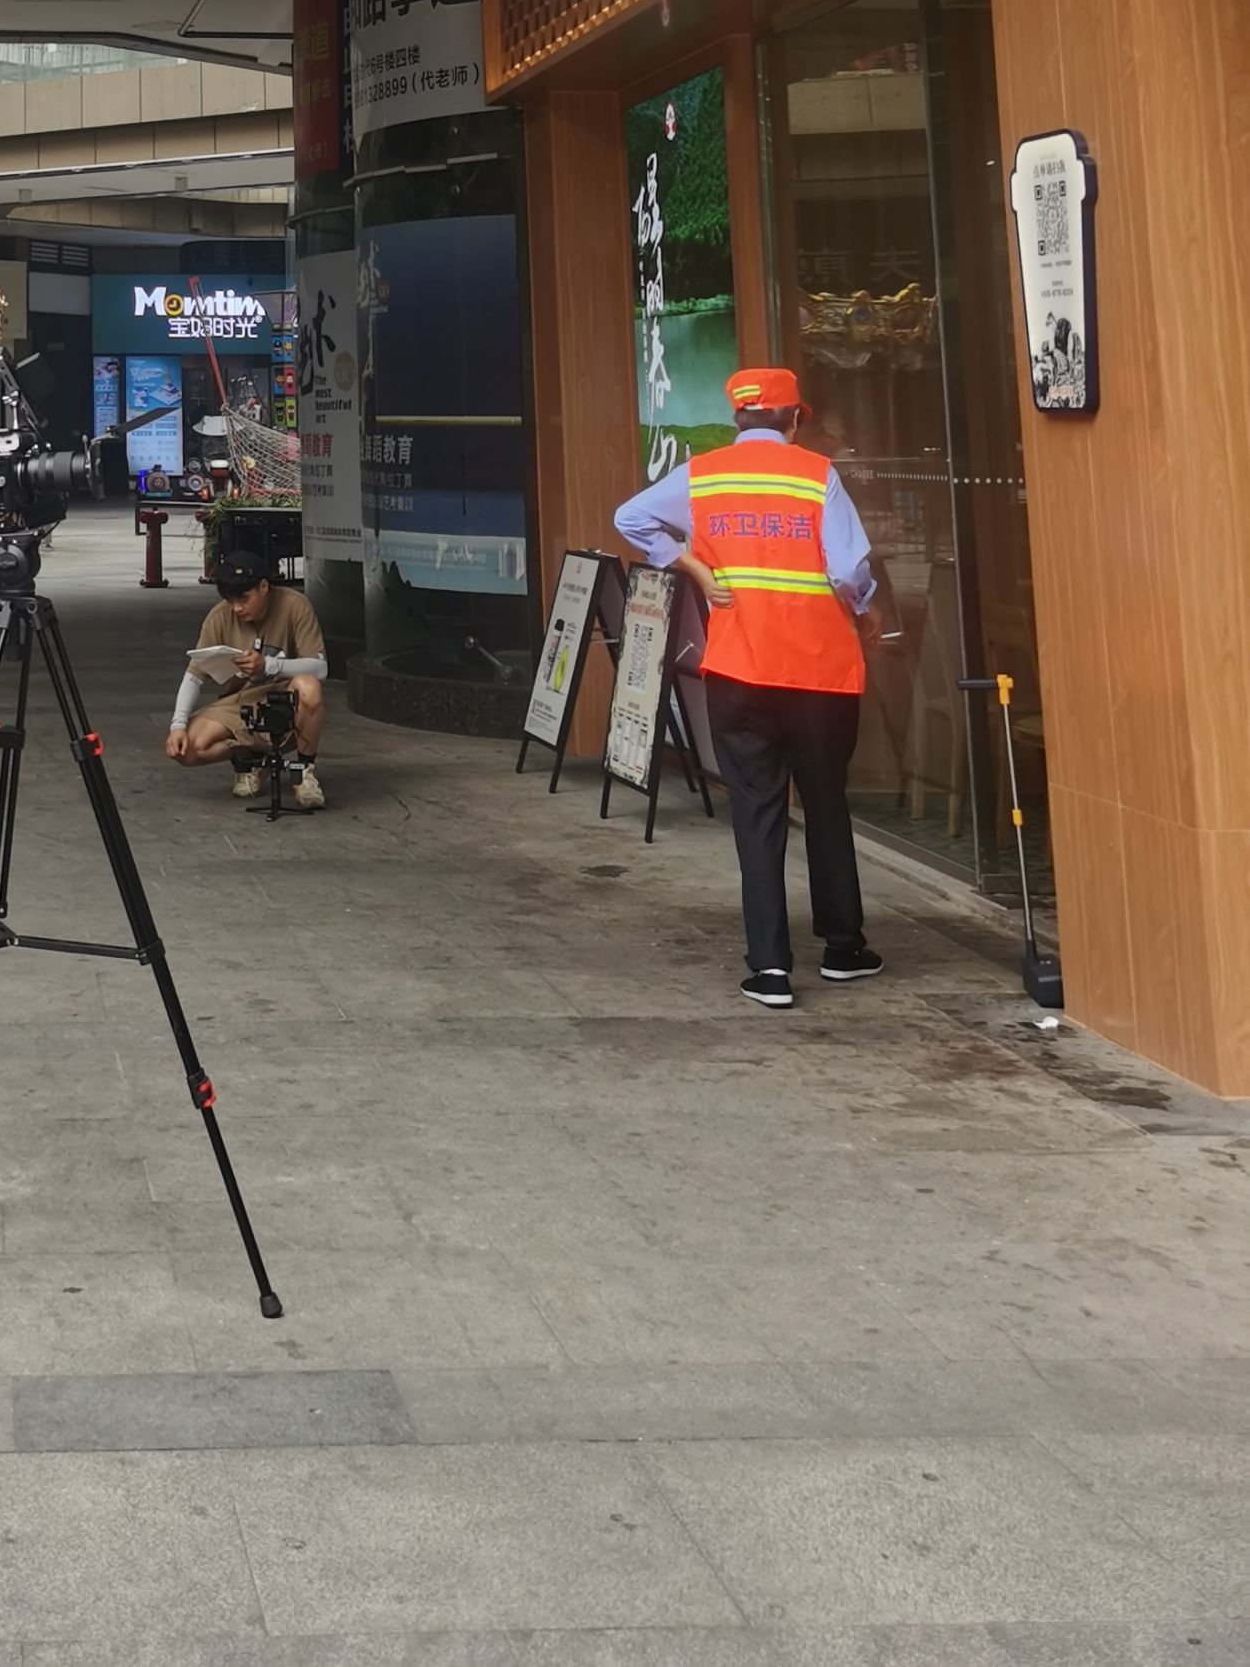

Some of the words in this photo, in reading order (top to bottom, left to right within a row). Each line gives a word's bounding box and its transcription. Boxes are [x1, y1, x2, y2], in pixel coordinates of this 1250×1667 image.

[315, 388, 332, 399] most
[315, 399, 352, 411] beautiful
[315, 414, 327, 424] art
[709, 512, 812, 540] 环卫保洁
